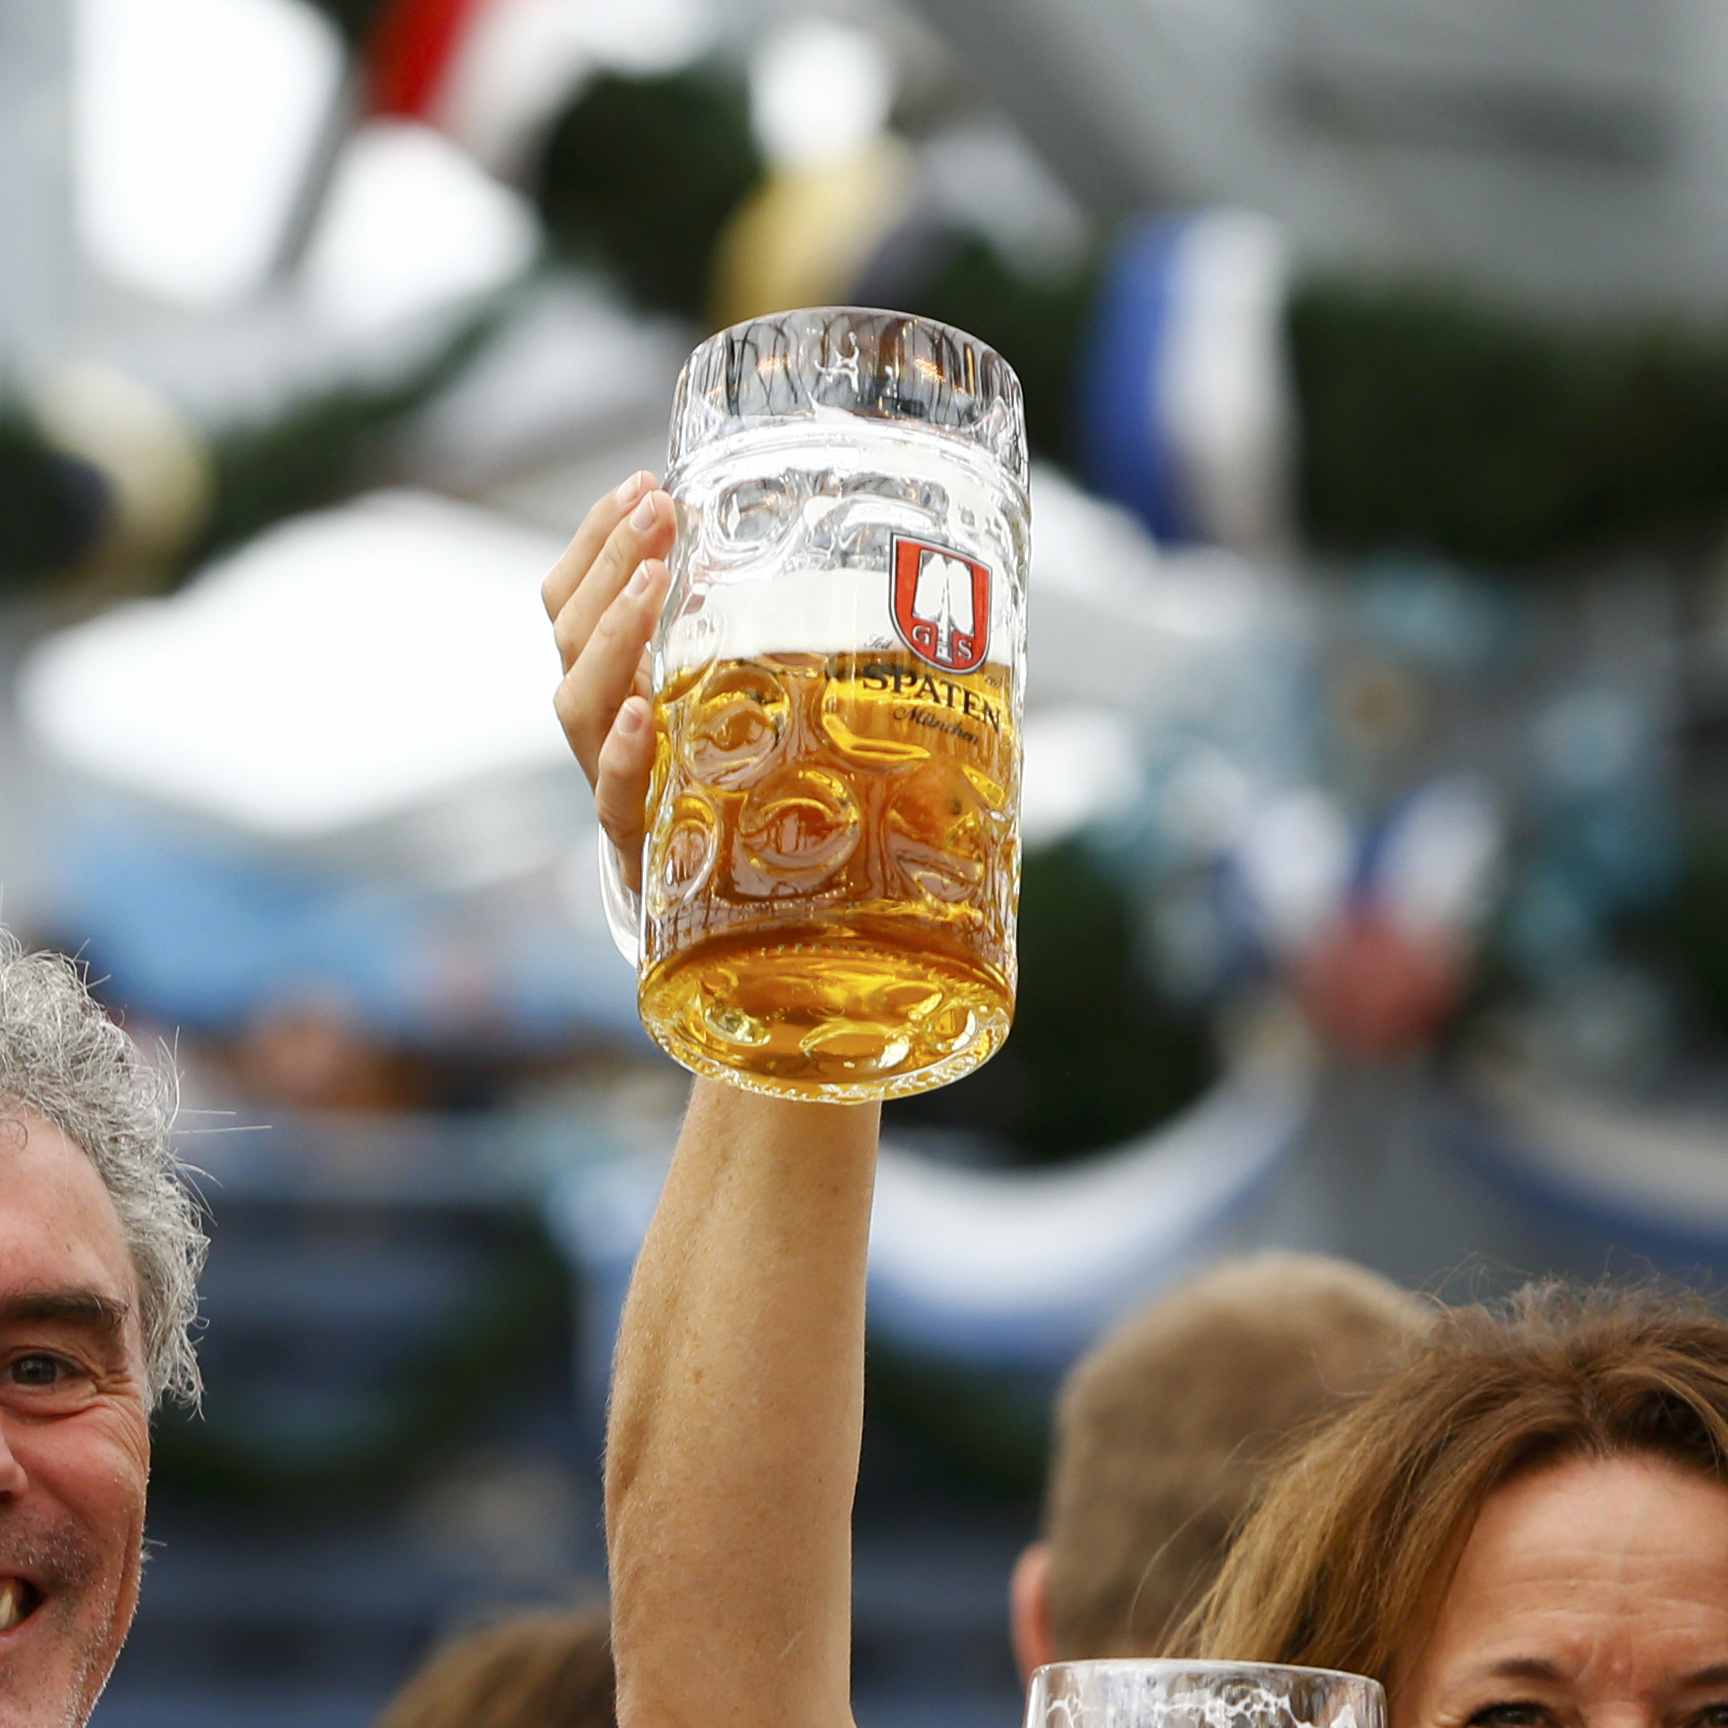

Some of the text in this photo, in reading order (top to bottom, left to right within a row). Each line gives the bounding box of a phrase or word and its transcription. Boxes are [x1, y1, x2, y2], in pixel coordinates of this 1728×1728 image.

[912, 624, 973, 661] G S
[862, 664, 1001, 734] SPATEN
